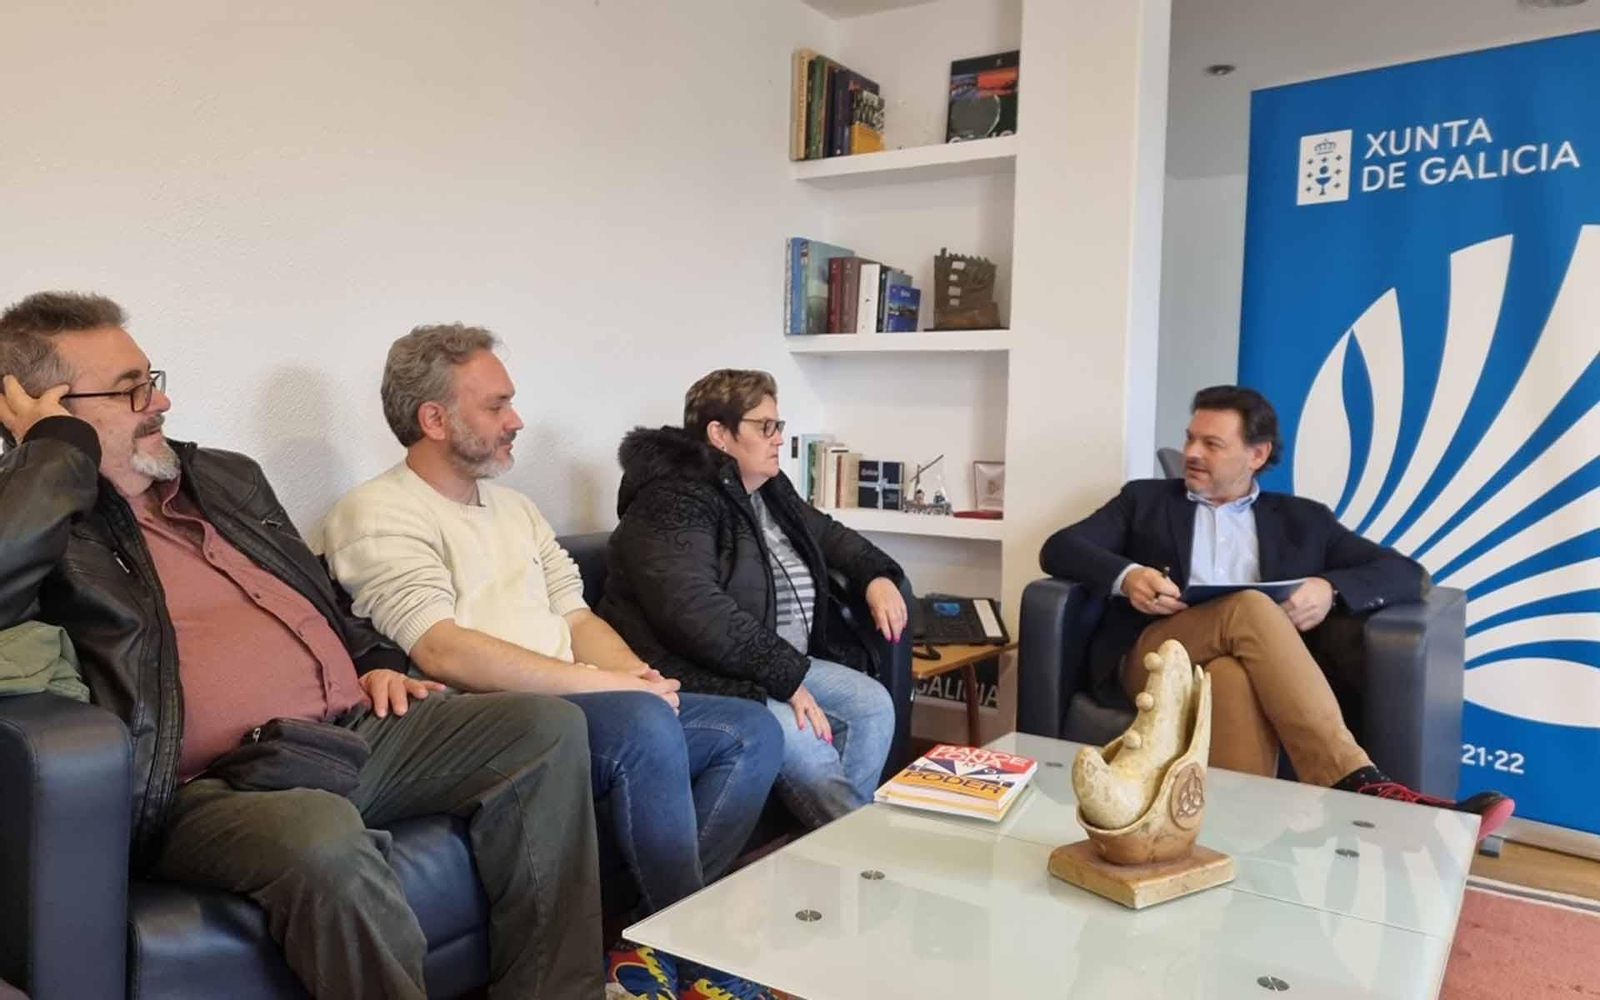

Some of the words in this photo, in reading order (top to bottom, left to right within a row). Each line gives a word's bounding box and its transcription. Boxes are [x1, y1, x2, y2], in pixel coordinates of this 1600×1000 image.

[1365, 117, 1492, 159] XUNTA
[1362, 162, 1407, 192] DE
[1419, 141, 1580, 185] GALICIA
[904, 771, 1000, 793] PODER
